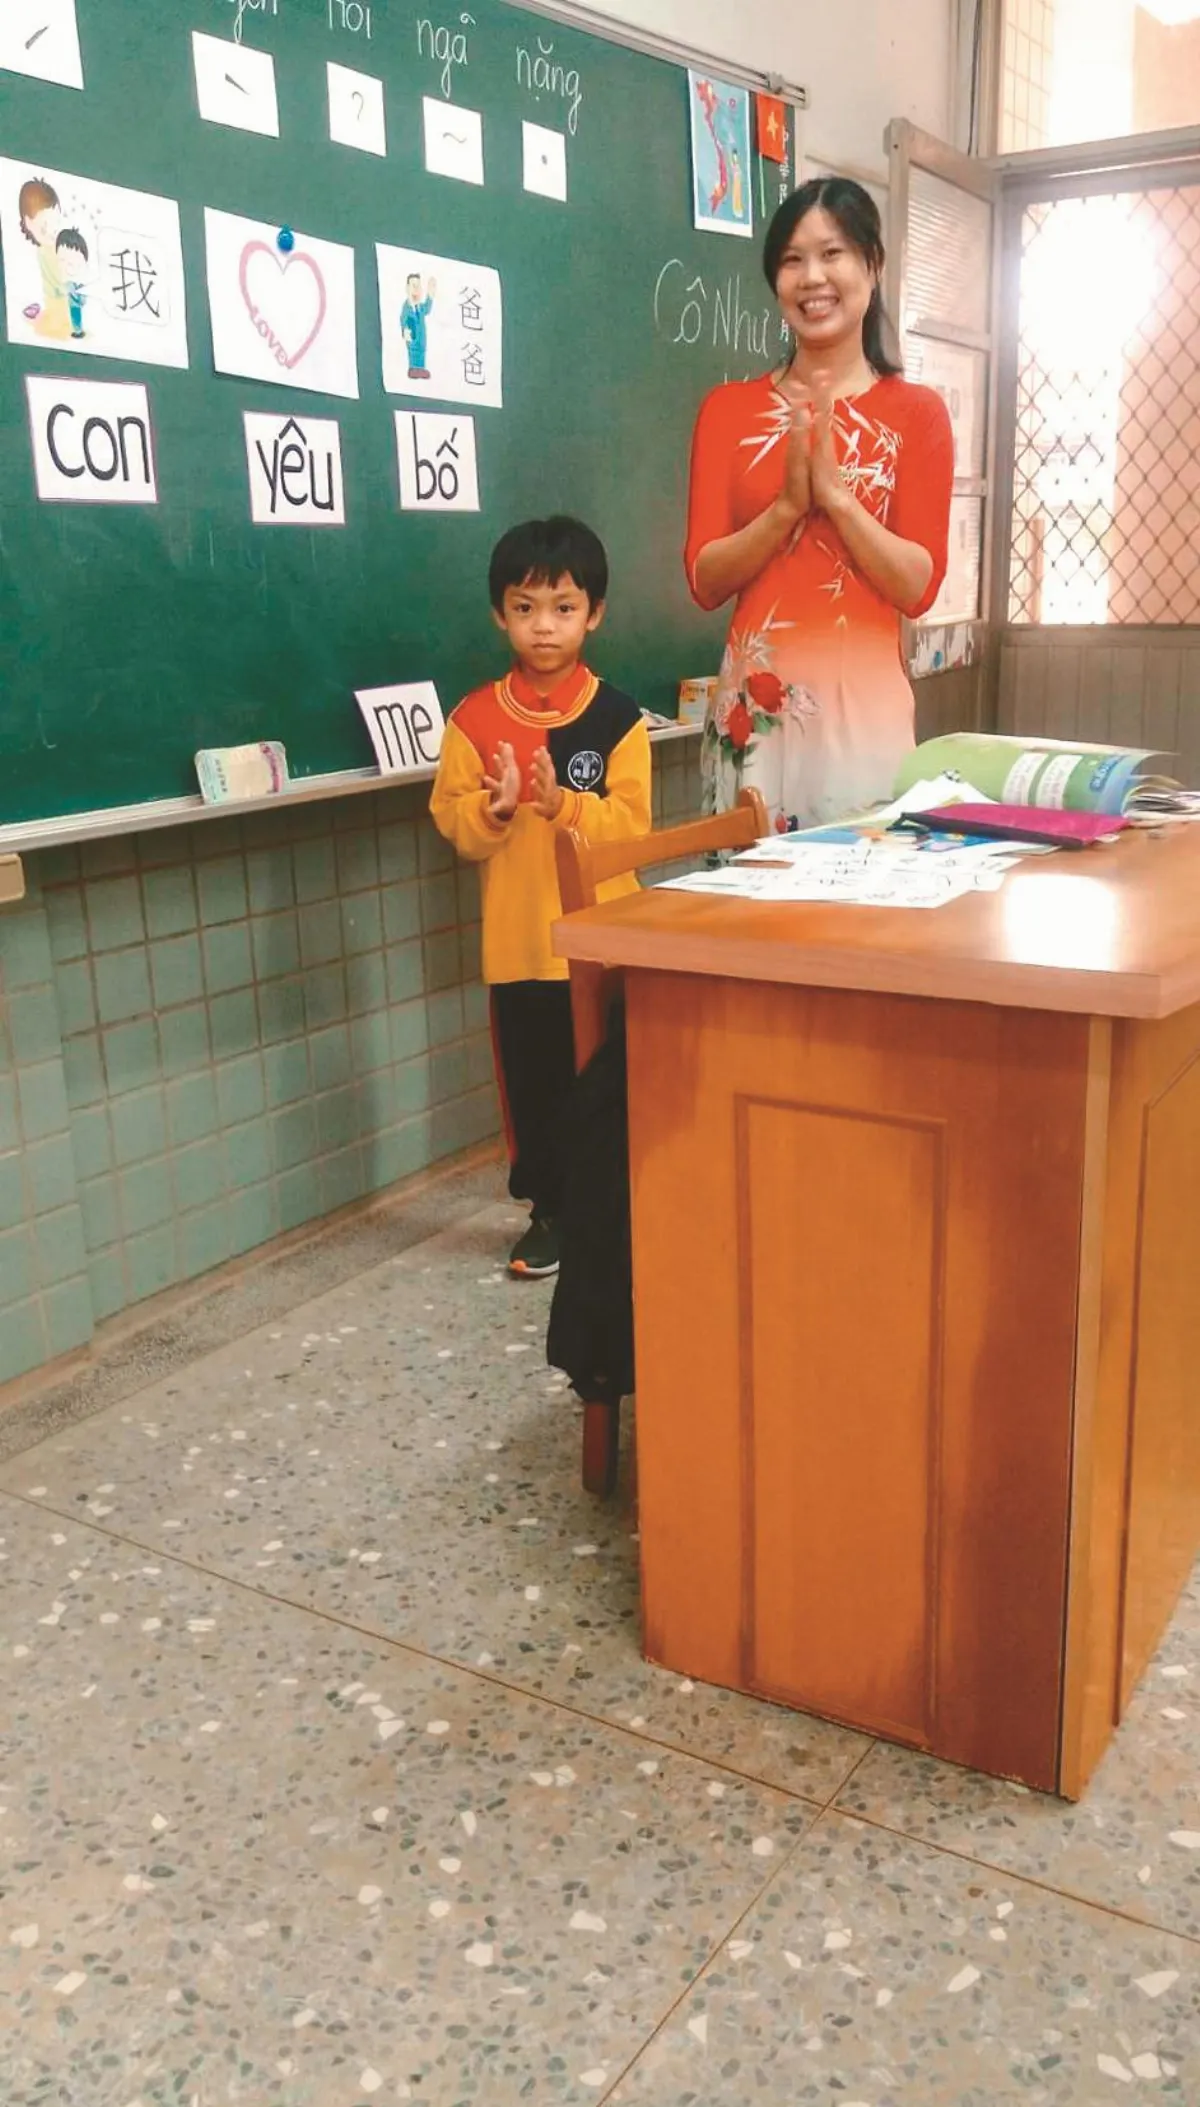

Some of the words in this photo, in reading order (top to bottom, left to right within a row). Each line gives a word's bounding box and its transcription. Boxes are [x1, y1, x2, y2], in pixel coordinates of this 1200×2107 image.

[416, 12, 476, 98] ngã
[516, 35, 583, 136] nặng
[109, 249, 161, 318] 我
[654, 258, 707, 344] Cô
[713, 274, 770, 359] Như
[458, 285, 486, 385] 爸爸
[256, 417, 335, 513] yêu
[411, 414, 460, 501] bố
